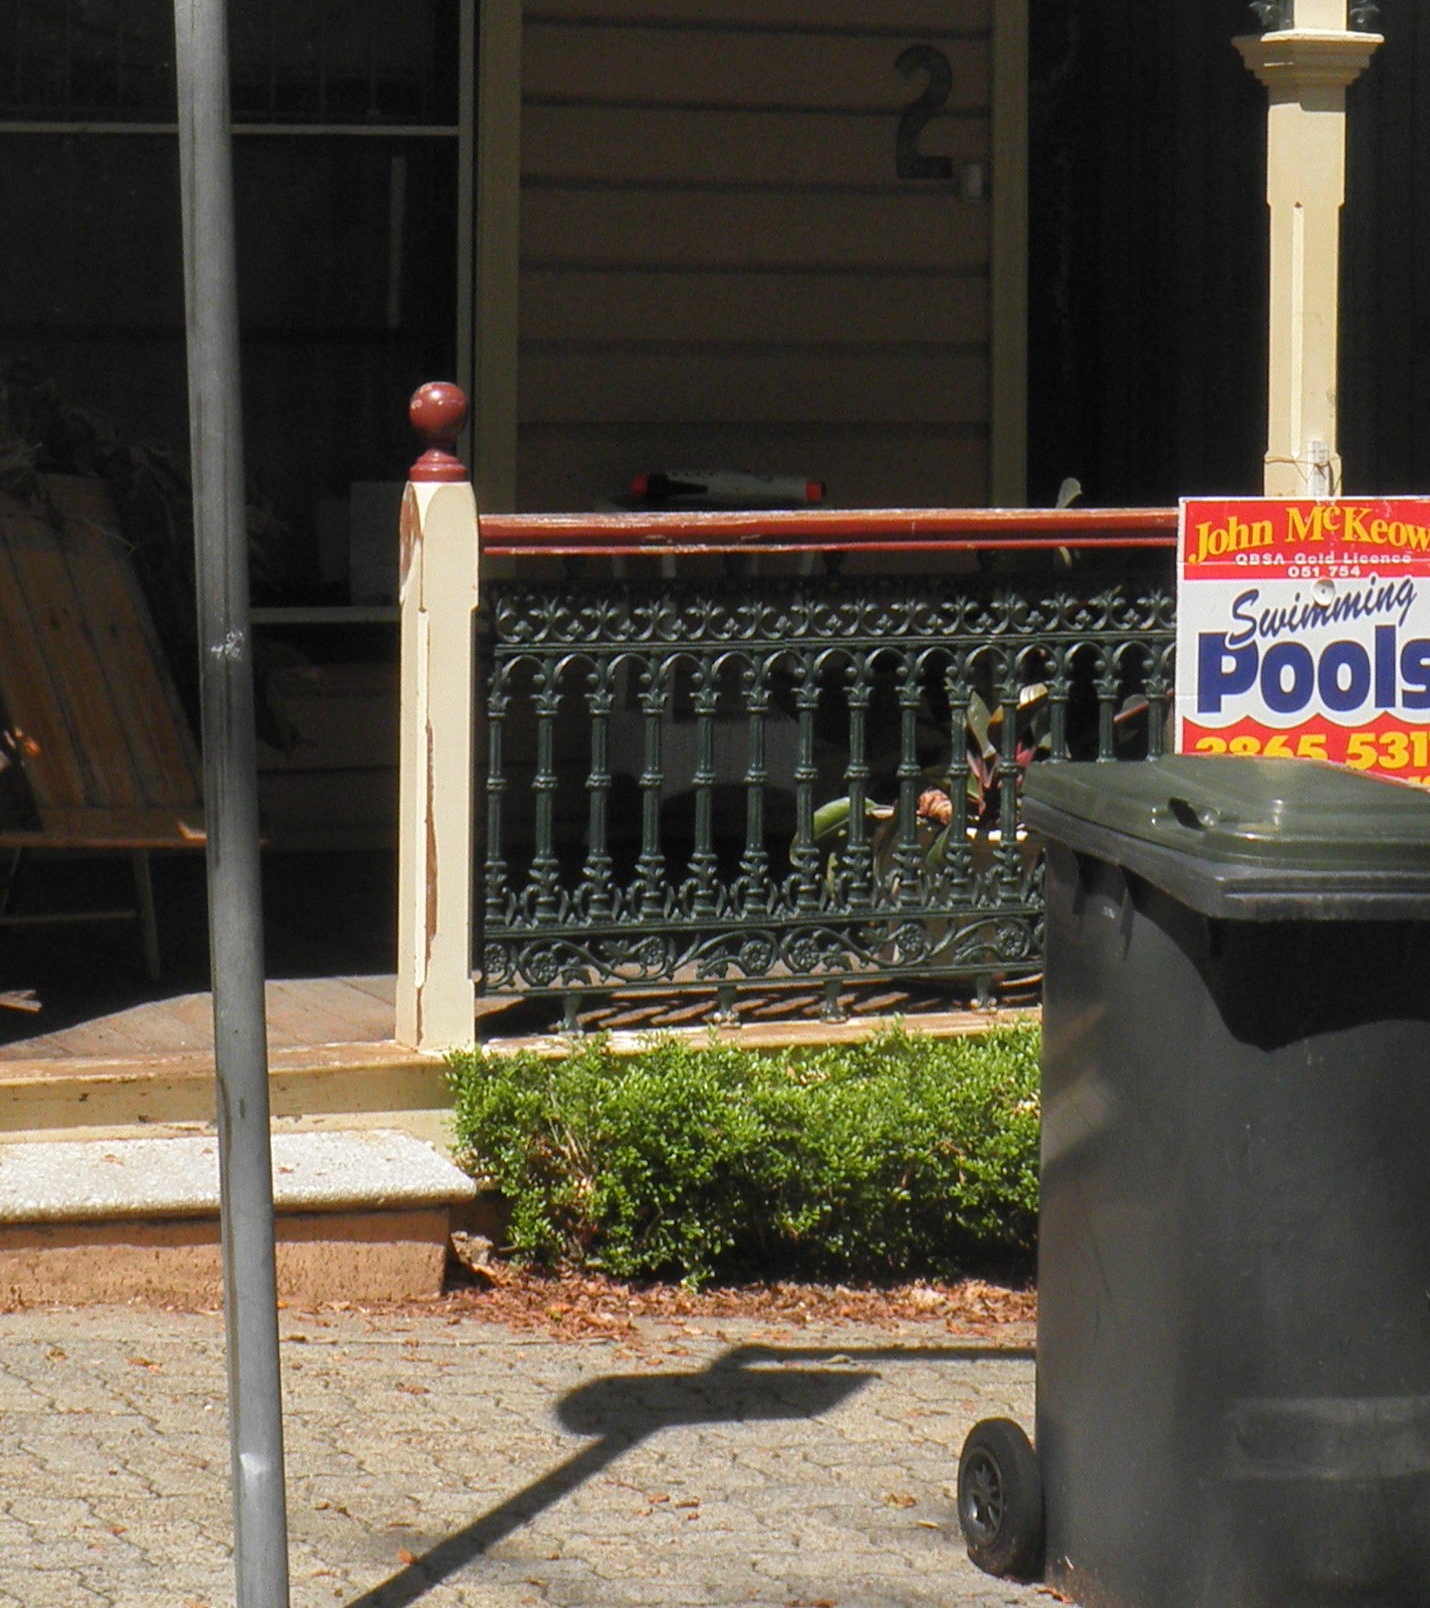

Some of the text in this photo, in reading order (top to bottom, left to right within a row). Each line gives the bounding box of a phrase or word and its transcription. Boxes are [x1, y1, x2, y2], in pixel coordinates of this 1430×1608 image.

[894, 44, 953, 179] 2
[1187, 516, 1273, 564] John
[1235, 551, 1412, 565] QBSA Gold Licence
[1287, 565, 1361, 577] 051 754
[1228, 575, 1418, 645] Swimming
